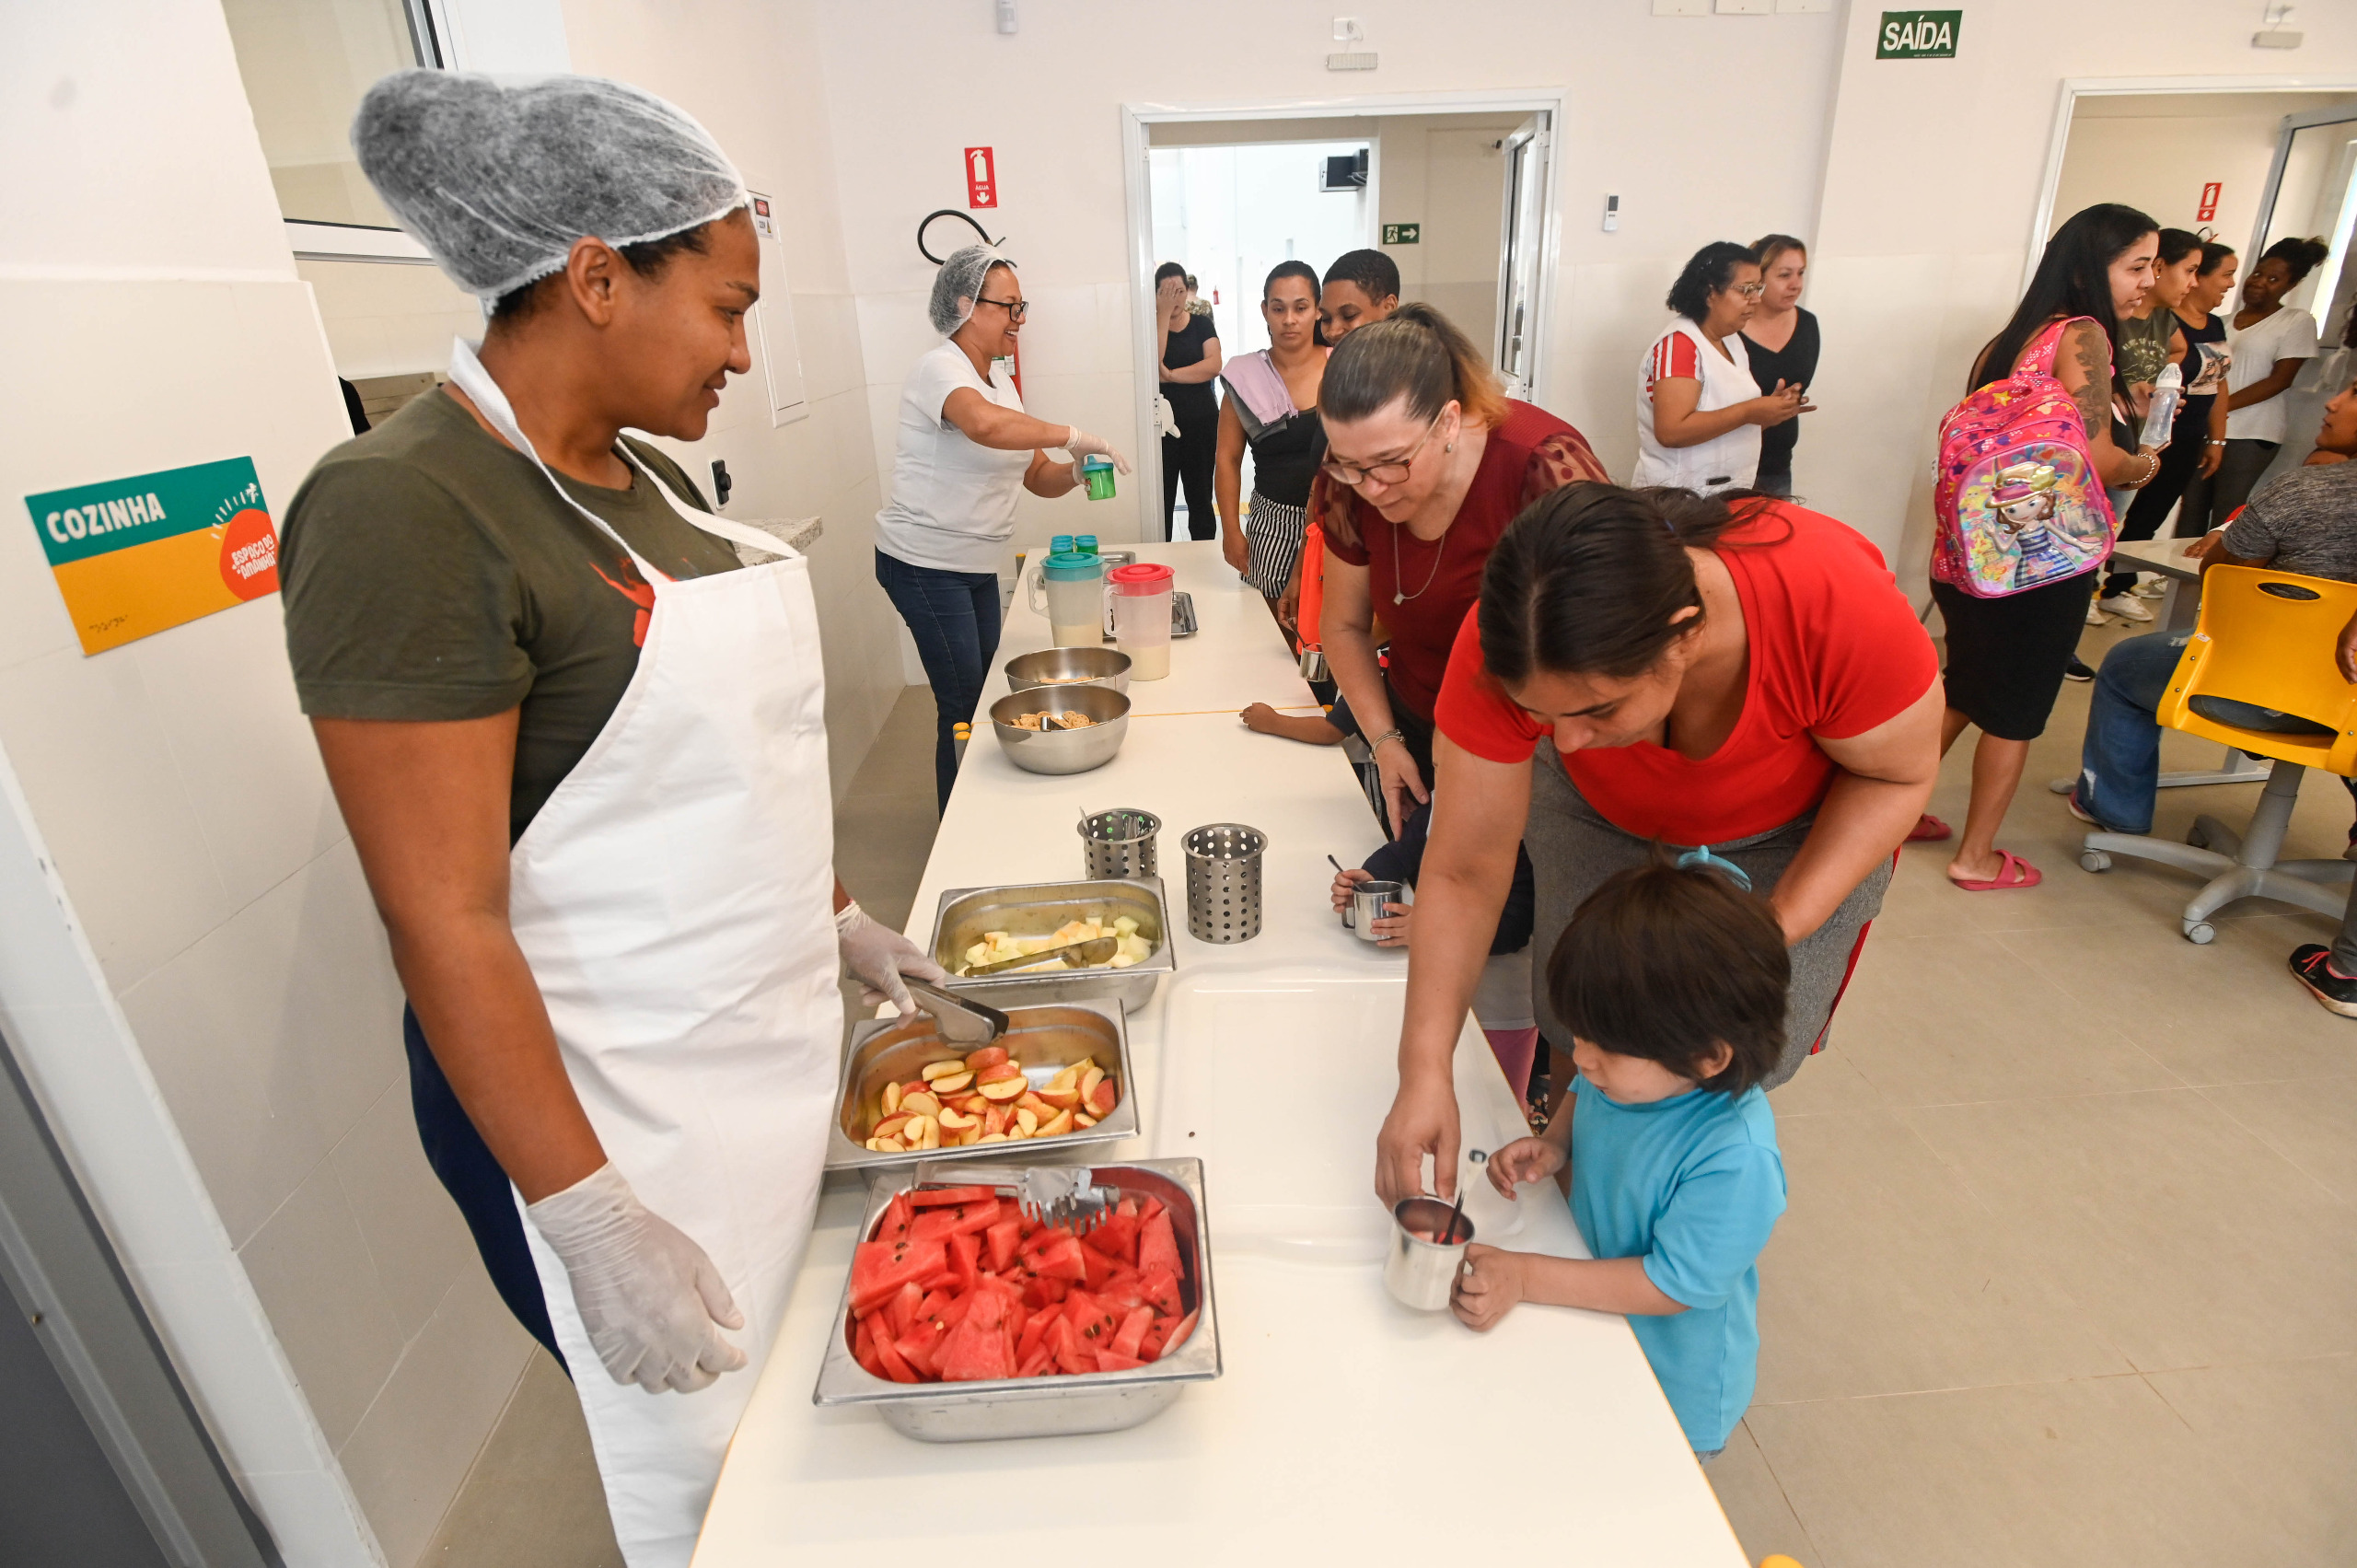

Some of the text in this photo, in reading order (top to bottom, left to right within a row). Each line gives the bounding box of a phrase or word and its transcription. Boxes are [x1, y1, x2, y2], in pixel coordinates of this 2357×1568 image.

[1883, 15, 1952, 51] SAÍDA
[46, 493, 166, 543] COZINHA
[231, 534, 274, 566] ESPAÇO DO
